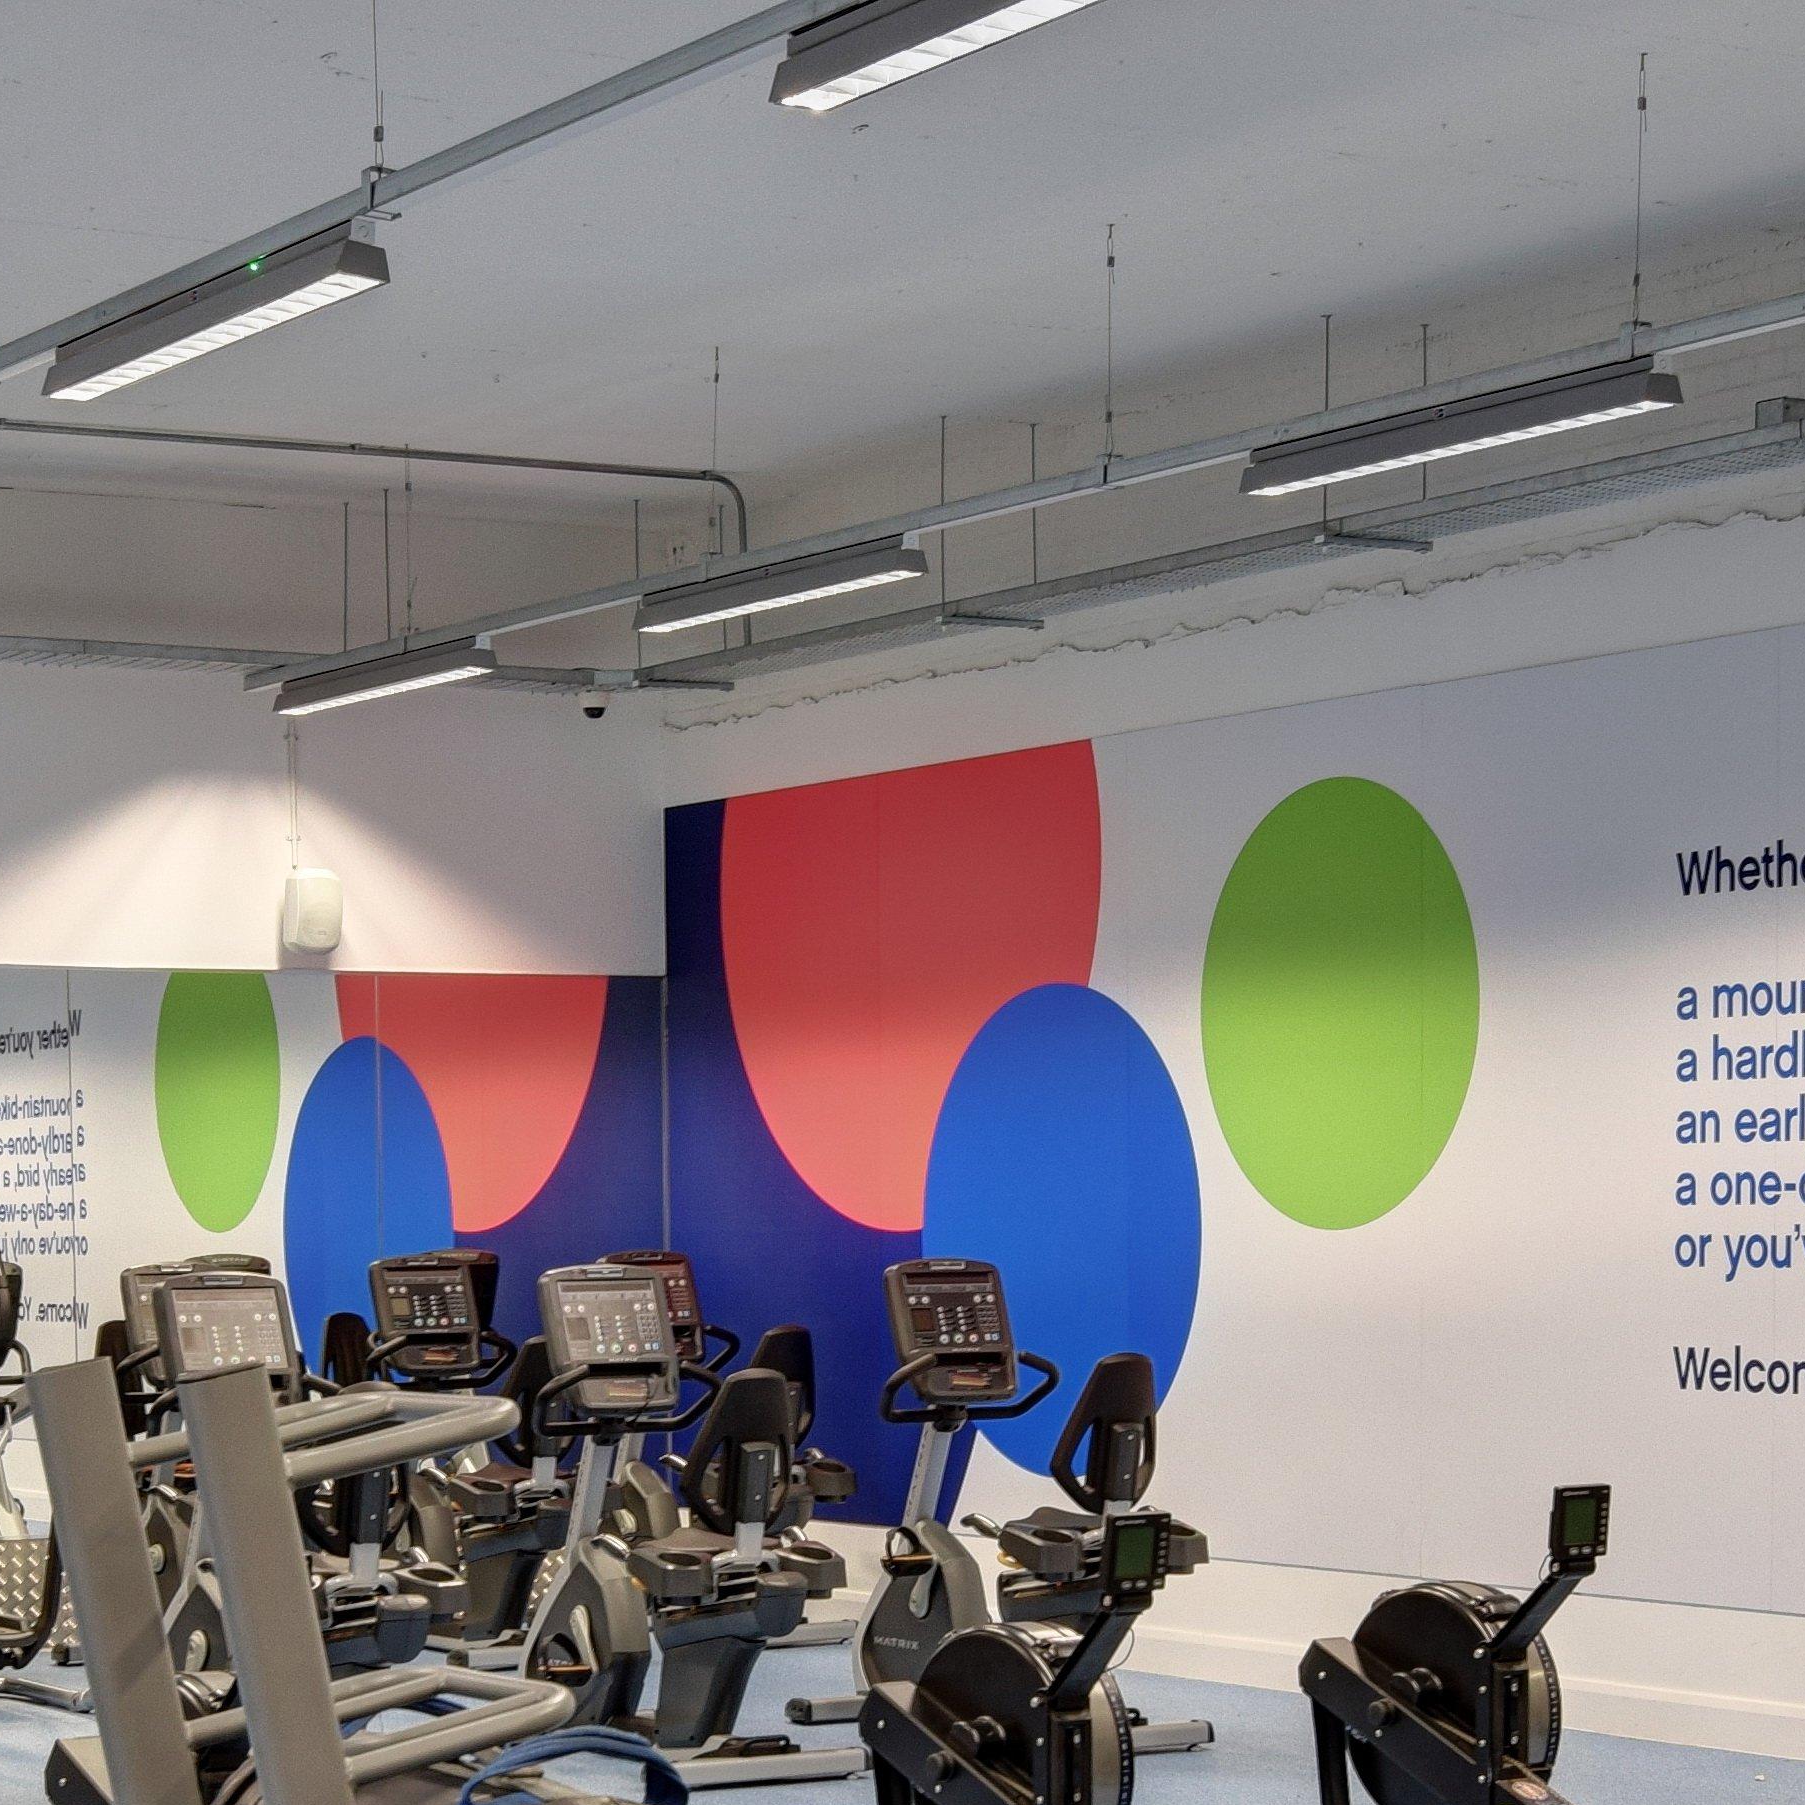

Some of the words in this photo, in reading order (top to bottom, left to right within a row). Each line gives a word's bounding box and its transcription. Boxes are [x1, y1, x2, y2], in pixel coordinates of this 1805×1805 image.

[1676, 986, 1698, 1021] a
[1676, 1048, 1698, 1083] a
[1676, 1109, 1721, 1144] an
[1675, 1172, 1696, 1206] a
[1674, 1234, 1712, 1268] or
